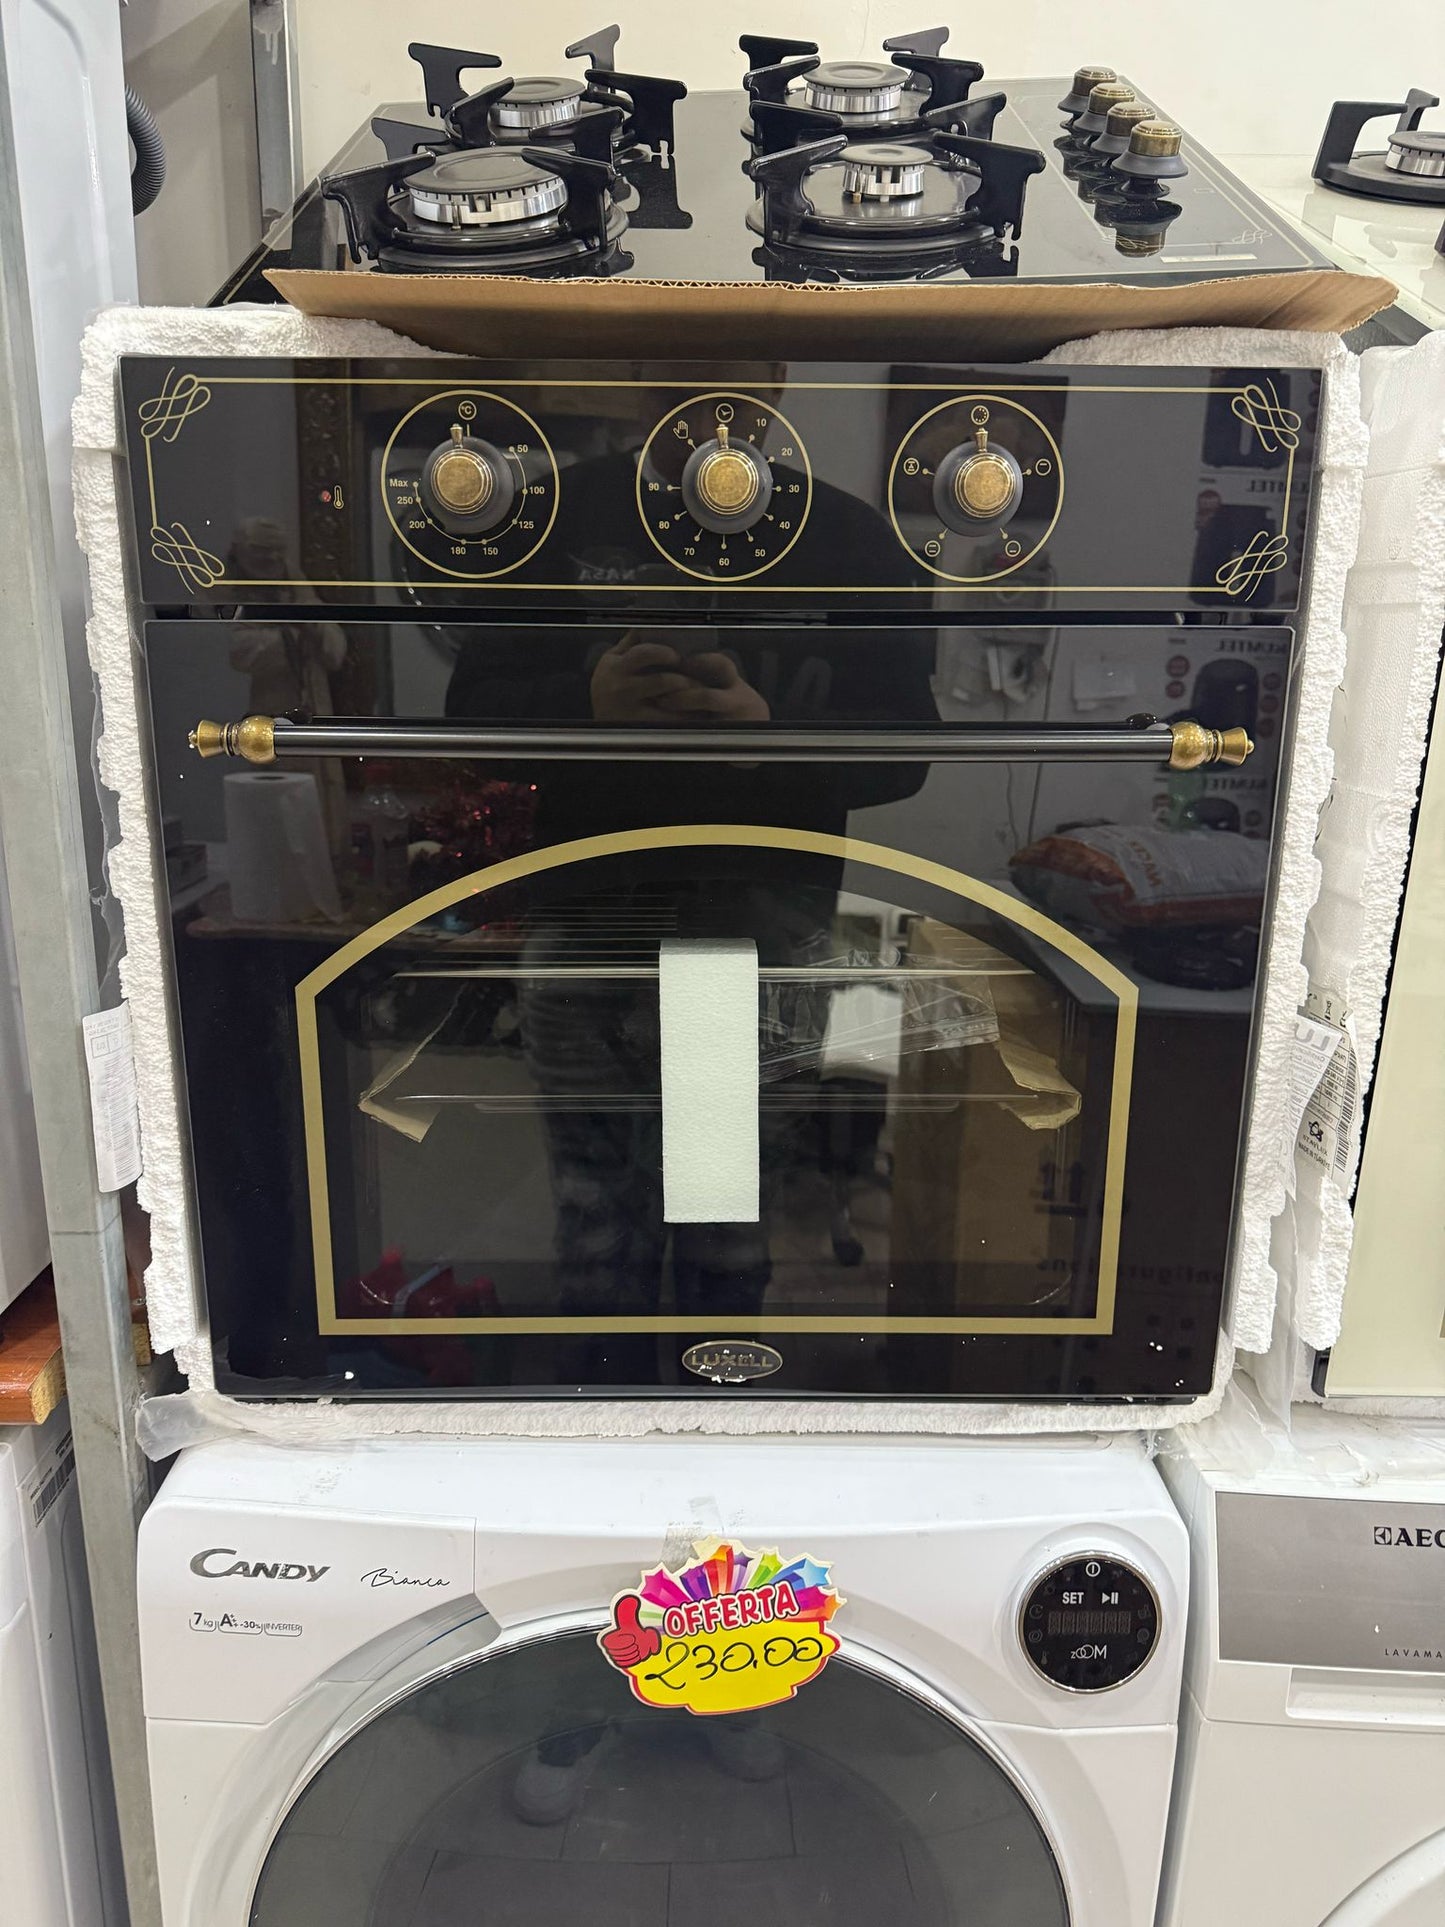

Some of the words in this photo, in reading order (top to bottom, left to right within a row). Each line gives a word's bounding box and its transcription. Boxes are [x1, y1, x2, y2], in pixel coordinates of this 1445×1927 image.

[756, 418, 767, 427] 10
[517, 444, 529, 453] 50
[781, 448, 793, 456] 20
[389, 478, 409, 488] Max
[648, 483, 660, 491] 90
[529, 486, 545, 495] 100
[788, 484, 800, 493] 30
[397, 496, 414, 505] 250
[409, 521, 425, 529] 200
[518, 521, 535, 530] 125
[658, 521, 670, 530] 80
[779, 521, 791, 530] 40
[450, 546, 466, 555] 180
[483, 547, 499, 556] 150
[684, 547, 695, 556] 70
[754, 549, 766, 557] 50
[718, 557, 730, 566] 60
[691, 1353, 774, 1368] LUXELL
[190, 1547, 332, 1582] CANDY
[360, 1567, 451, 1588] Bianca
[1062, 1591, 1085, 1605] SET
[664, 1582, 800, 1637] OFFERTA
[193, 1612, 203, 1626] 7
[265, 1622, 302, 1632] INVERTER
